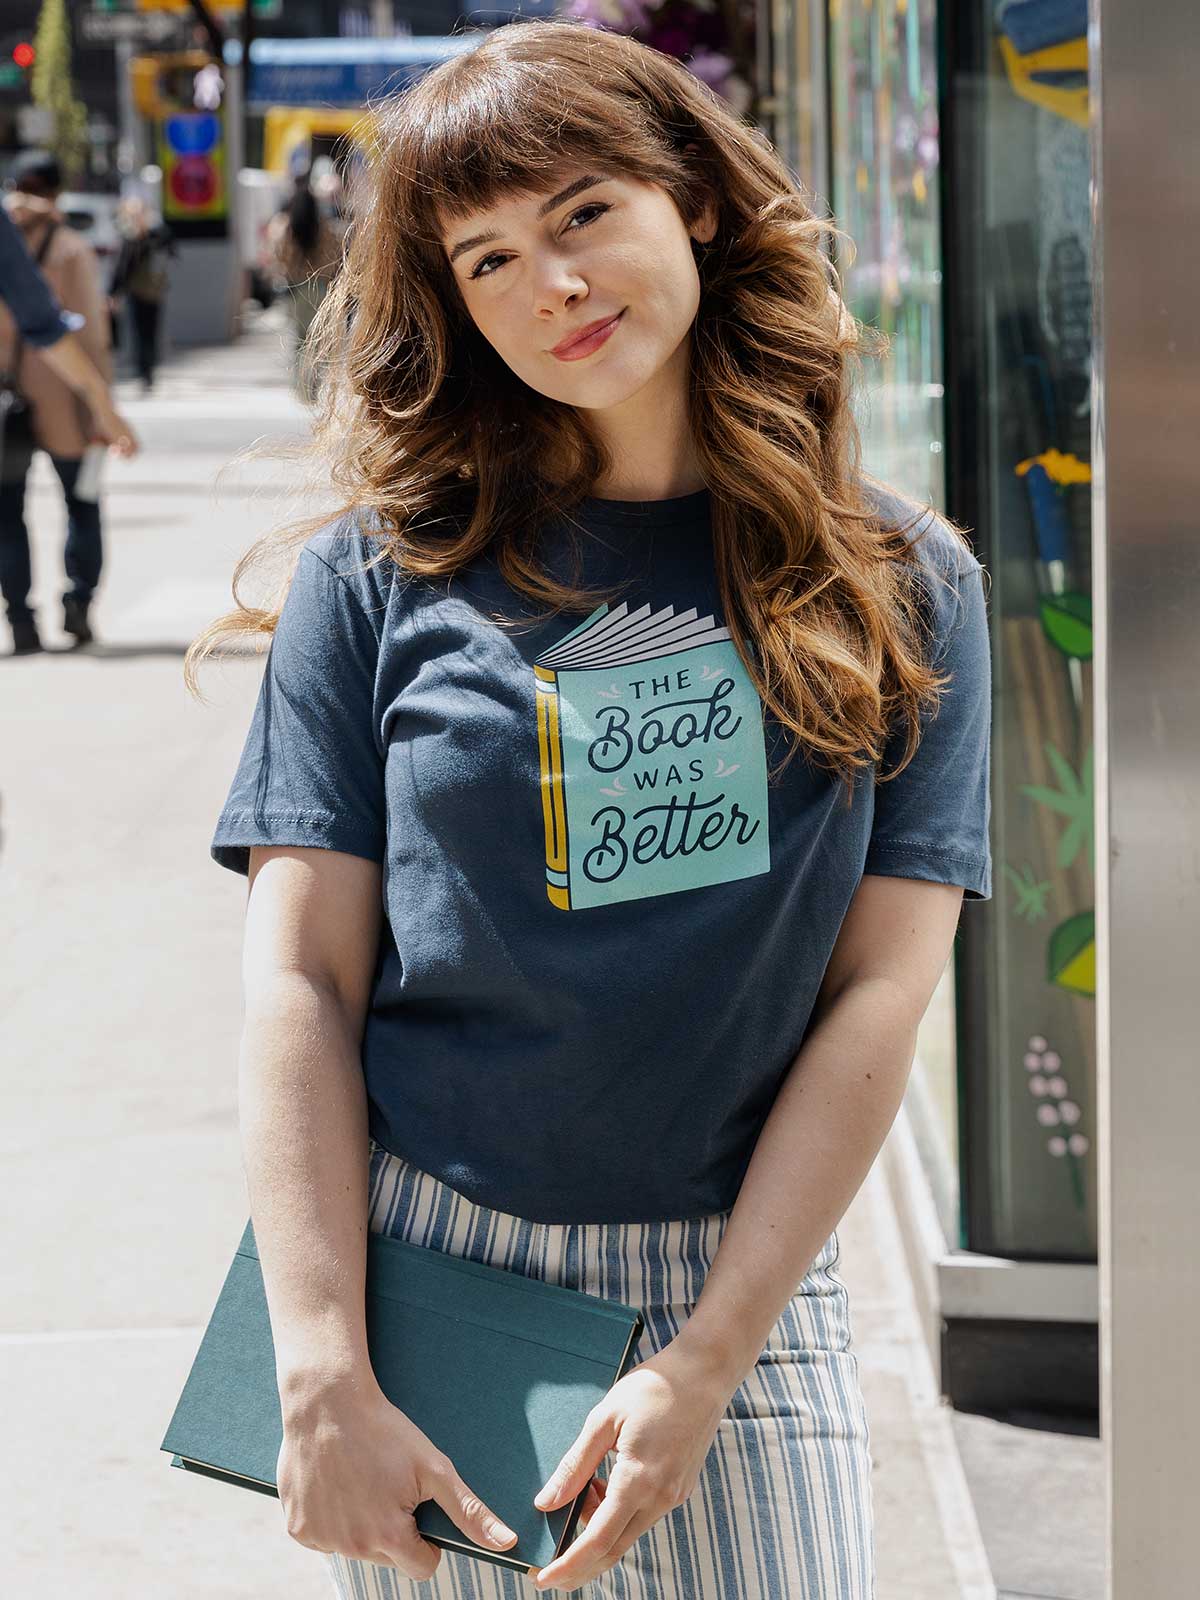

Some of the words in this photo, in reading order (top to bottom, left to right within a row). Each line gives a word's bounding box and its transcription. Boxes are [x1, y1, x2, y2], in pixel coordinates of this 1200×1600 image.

[629, 669, 692, 699] THE
[588, 678, 742, 773] Book
[633, 759, 704, 790] WAS
[583, 792, 760, 883] Better
